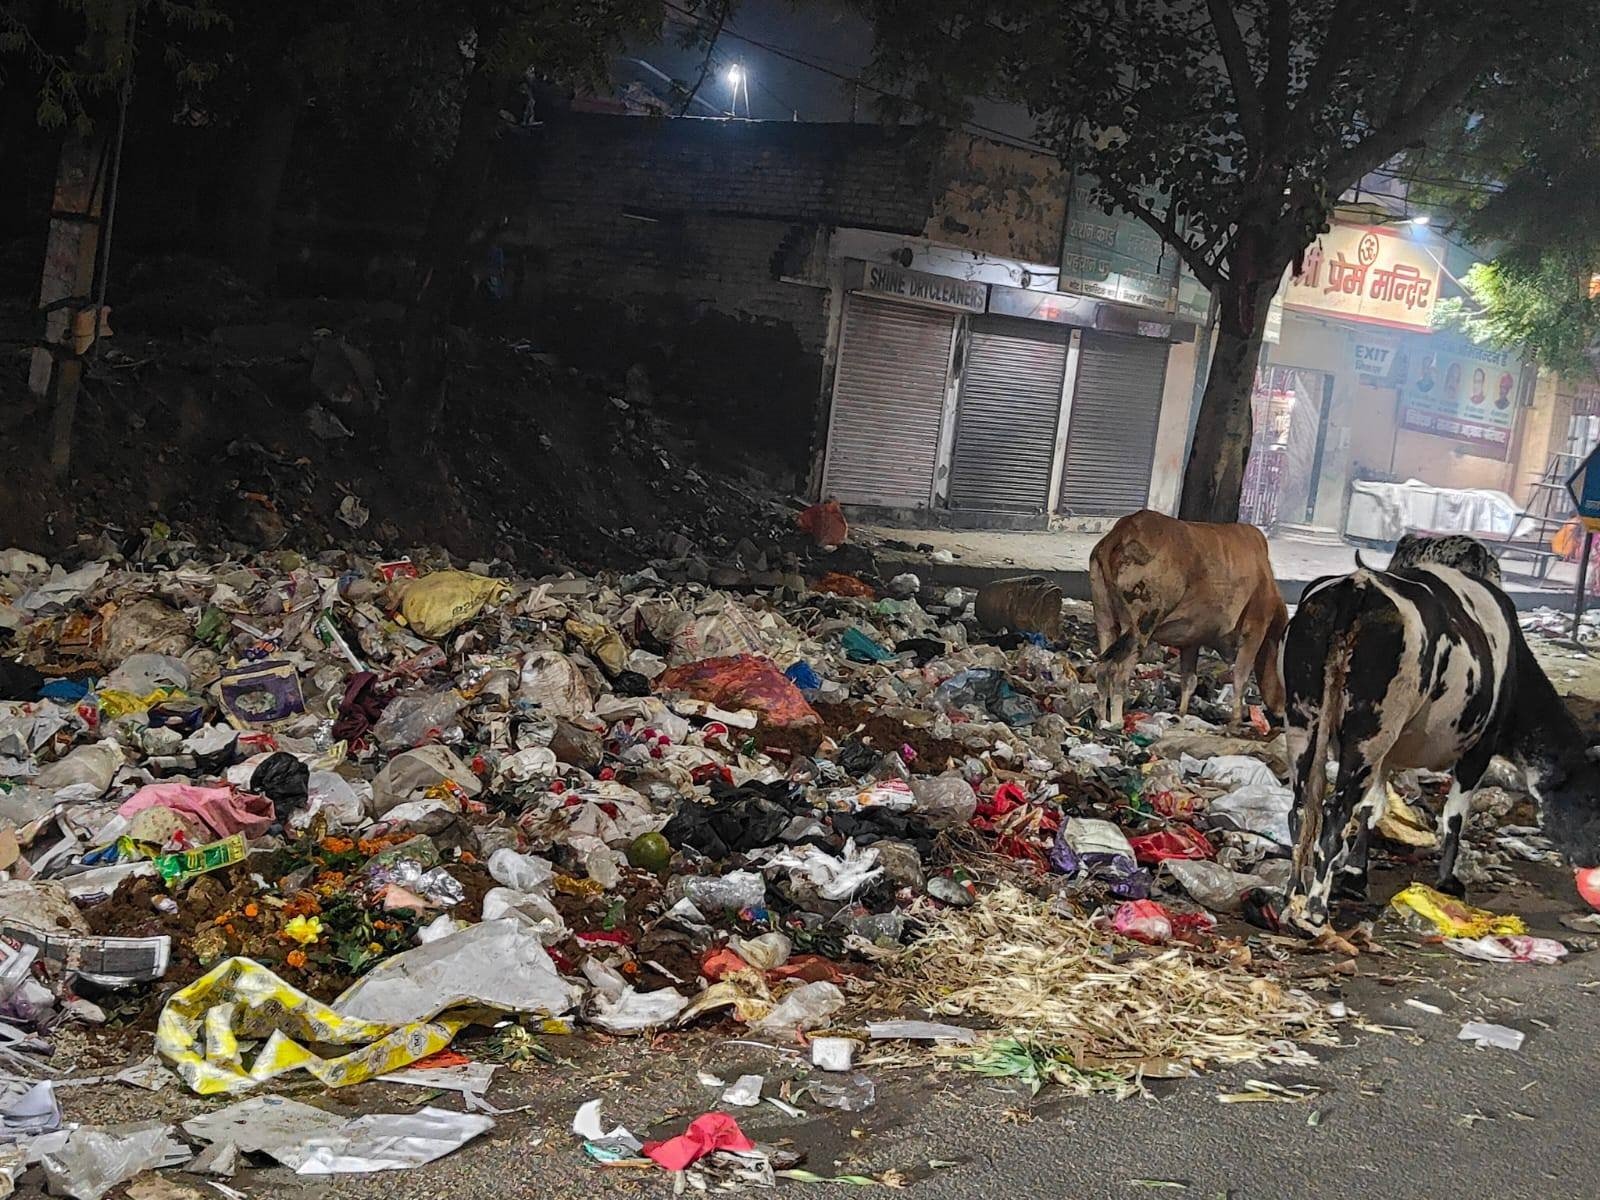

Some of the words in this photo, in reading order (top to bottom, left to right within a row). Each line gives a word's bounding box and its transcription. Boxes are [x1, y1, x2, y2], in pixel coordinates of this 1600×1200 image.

[870, 267, 906, 295] SHINE
[909, 277, 985, 308] DRYCLEANERS
[1324, 251, 1369, 297] प्रेम
[1370, 263, 1432, 310] मन्दिर
[1355, 345, 1389, 362] EXIT
